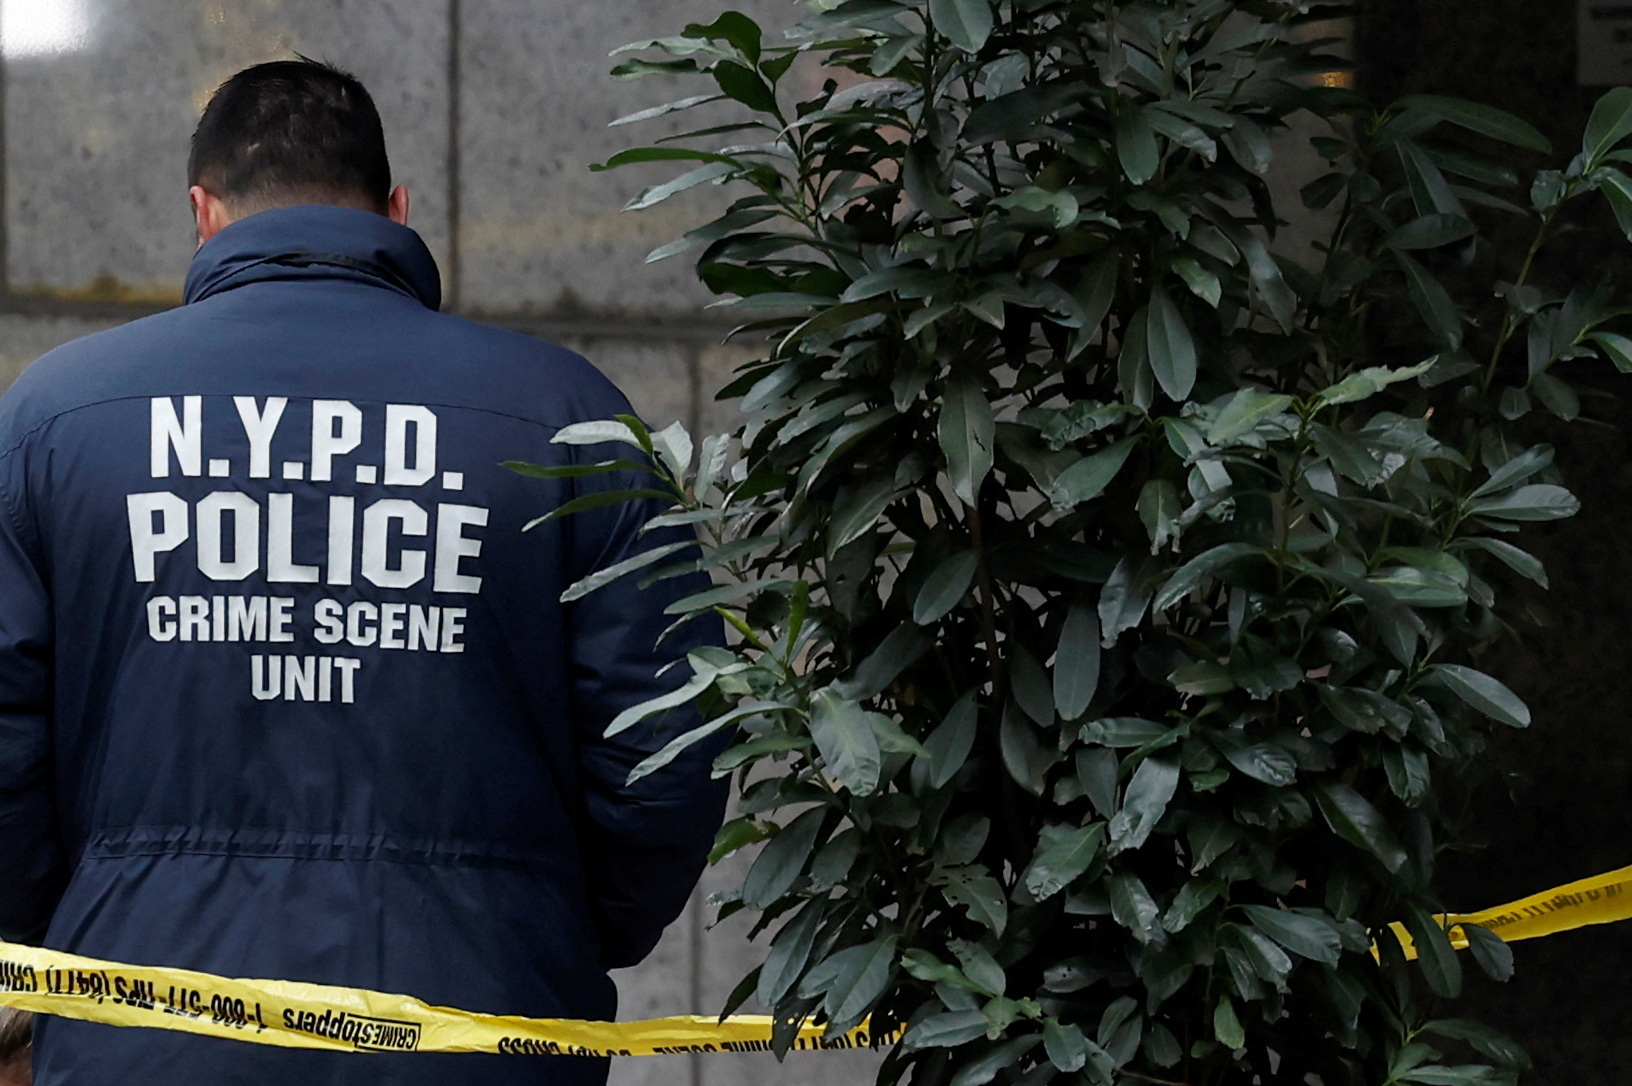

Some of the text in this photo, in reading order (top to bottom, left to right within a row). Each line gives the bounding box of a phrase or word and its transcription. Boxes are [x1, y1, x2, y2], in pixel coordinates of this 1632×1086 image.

[150, 395, 464, 490] N.Y.P.D.
[126, 491, 490, 594] POLICE
[146, 594, 468, 654] CRIME SCENE
[250, 654, 361, 704] UNIT
